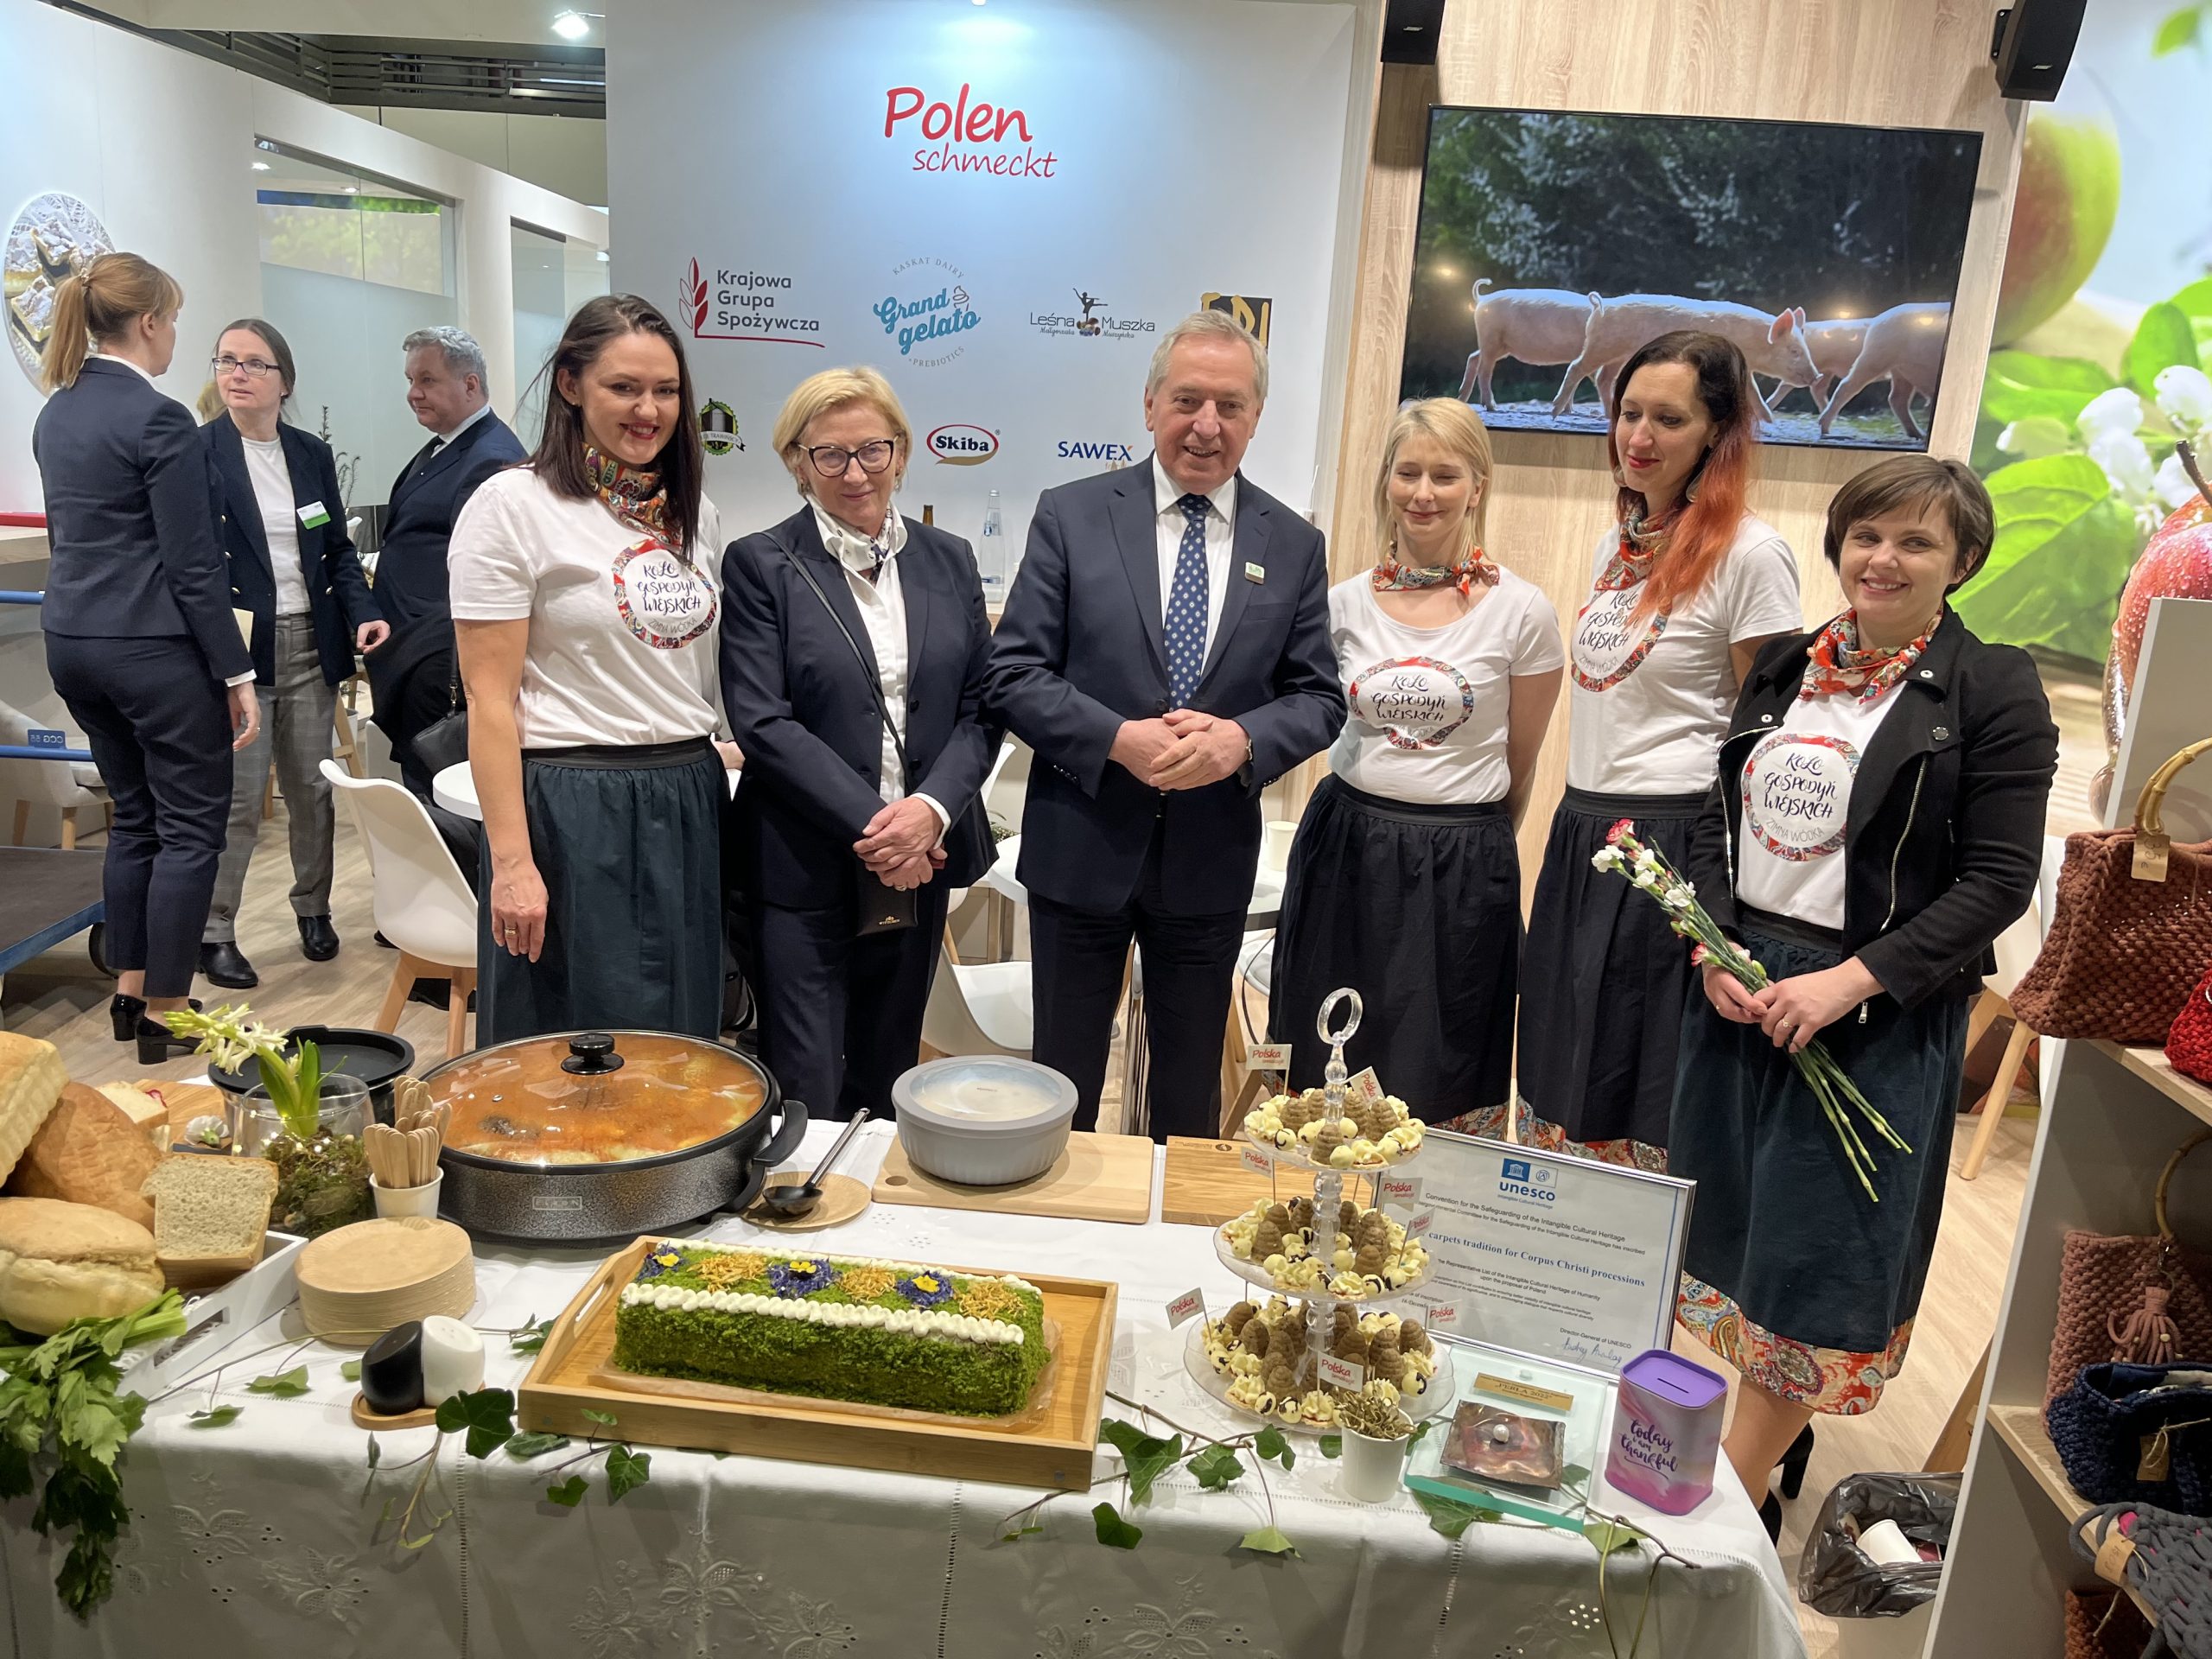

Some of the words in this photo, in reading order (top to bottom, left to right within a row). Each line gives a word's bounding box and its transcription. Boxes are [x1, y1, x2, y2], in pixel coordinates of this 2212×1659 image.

[884, 82, 1033, 143] Polen
[912, 141, 1058, 178] schmeckt
[893, 257, 931, 276] KASKAT
[935, 258, 964, 279] DAIRY
[716, 269, 791, 291] Krajowa
[716, 289, 775, 311] Grupa
[873, 288, 950, 334] Grand
[716, 310, 820, 334] Spożywcza
[898, 308, 982, 356] gelato
[1030, 312, 1075, 327] Leśna
[1102, 316, 1155, 332] Muszka
[912, 346, 965, 367] PREBIOTICS
[935, 435, 989, 452] Skiba
[1058, 441, 1134, 461] SAWEX
[643, 595, 702, 616] WIEJSKICH
[1764, 792, 1834, 820] WIEJSKICH
[1766, 817, 1789, 840] ZIMNA
[1790, 826, 1826, 842] WÓDKA
[1252, 1048, 1281, 1058] Polska
[1361, 1073, 1376, 1097] Polska
[1244, 1152, 1269, 1166] Polska
[1383, 1182, 1412, 1192] Polska
[1499, 1181, 1555, 1201] unesco
[1426, 1192, 1459, 1205] Convention
[1480, 1205, 1521, 1220] Safeguarding
[1541, 1218, 1571, 1230] Intangible
[1573, 1225, 1598, 1236] Cultural
[1598, 1230, 1625, 1243] Heritage
[1428, 1231, 1461, 1245] carpets
[1463, 1237, 1503, 1255] tradition
[1504, 1247, 1519, 1258] for
[1521, 1251, 1554, 1266] Corpus
[1556, 1260, 1590, 1274] Christi
[1591, 1268, 1645, 1287] processions
[1170, 1298, 1195, 1316] Polska
[1429, 1306, 1454, 1319] Polska
[1560, 1327, 1601, 1342] Director-General
[1607, 1338, 1632, 1349] UNESCO
[1321, 1359, 1351, 1376] Polska
[1630, 1417, 1674, 1453] today
[1637, 1440, 1651, 1452] am
[1618, 1433, 1678, 1472] thankful
